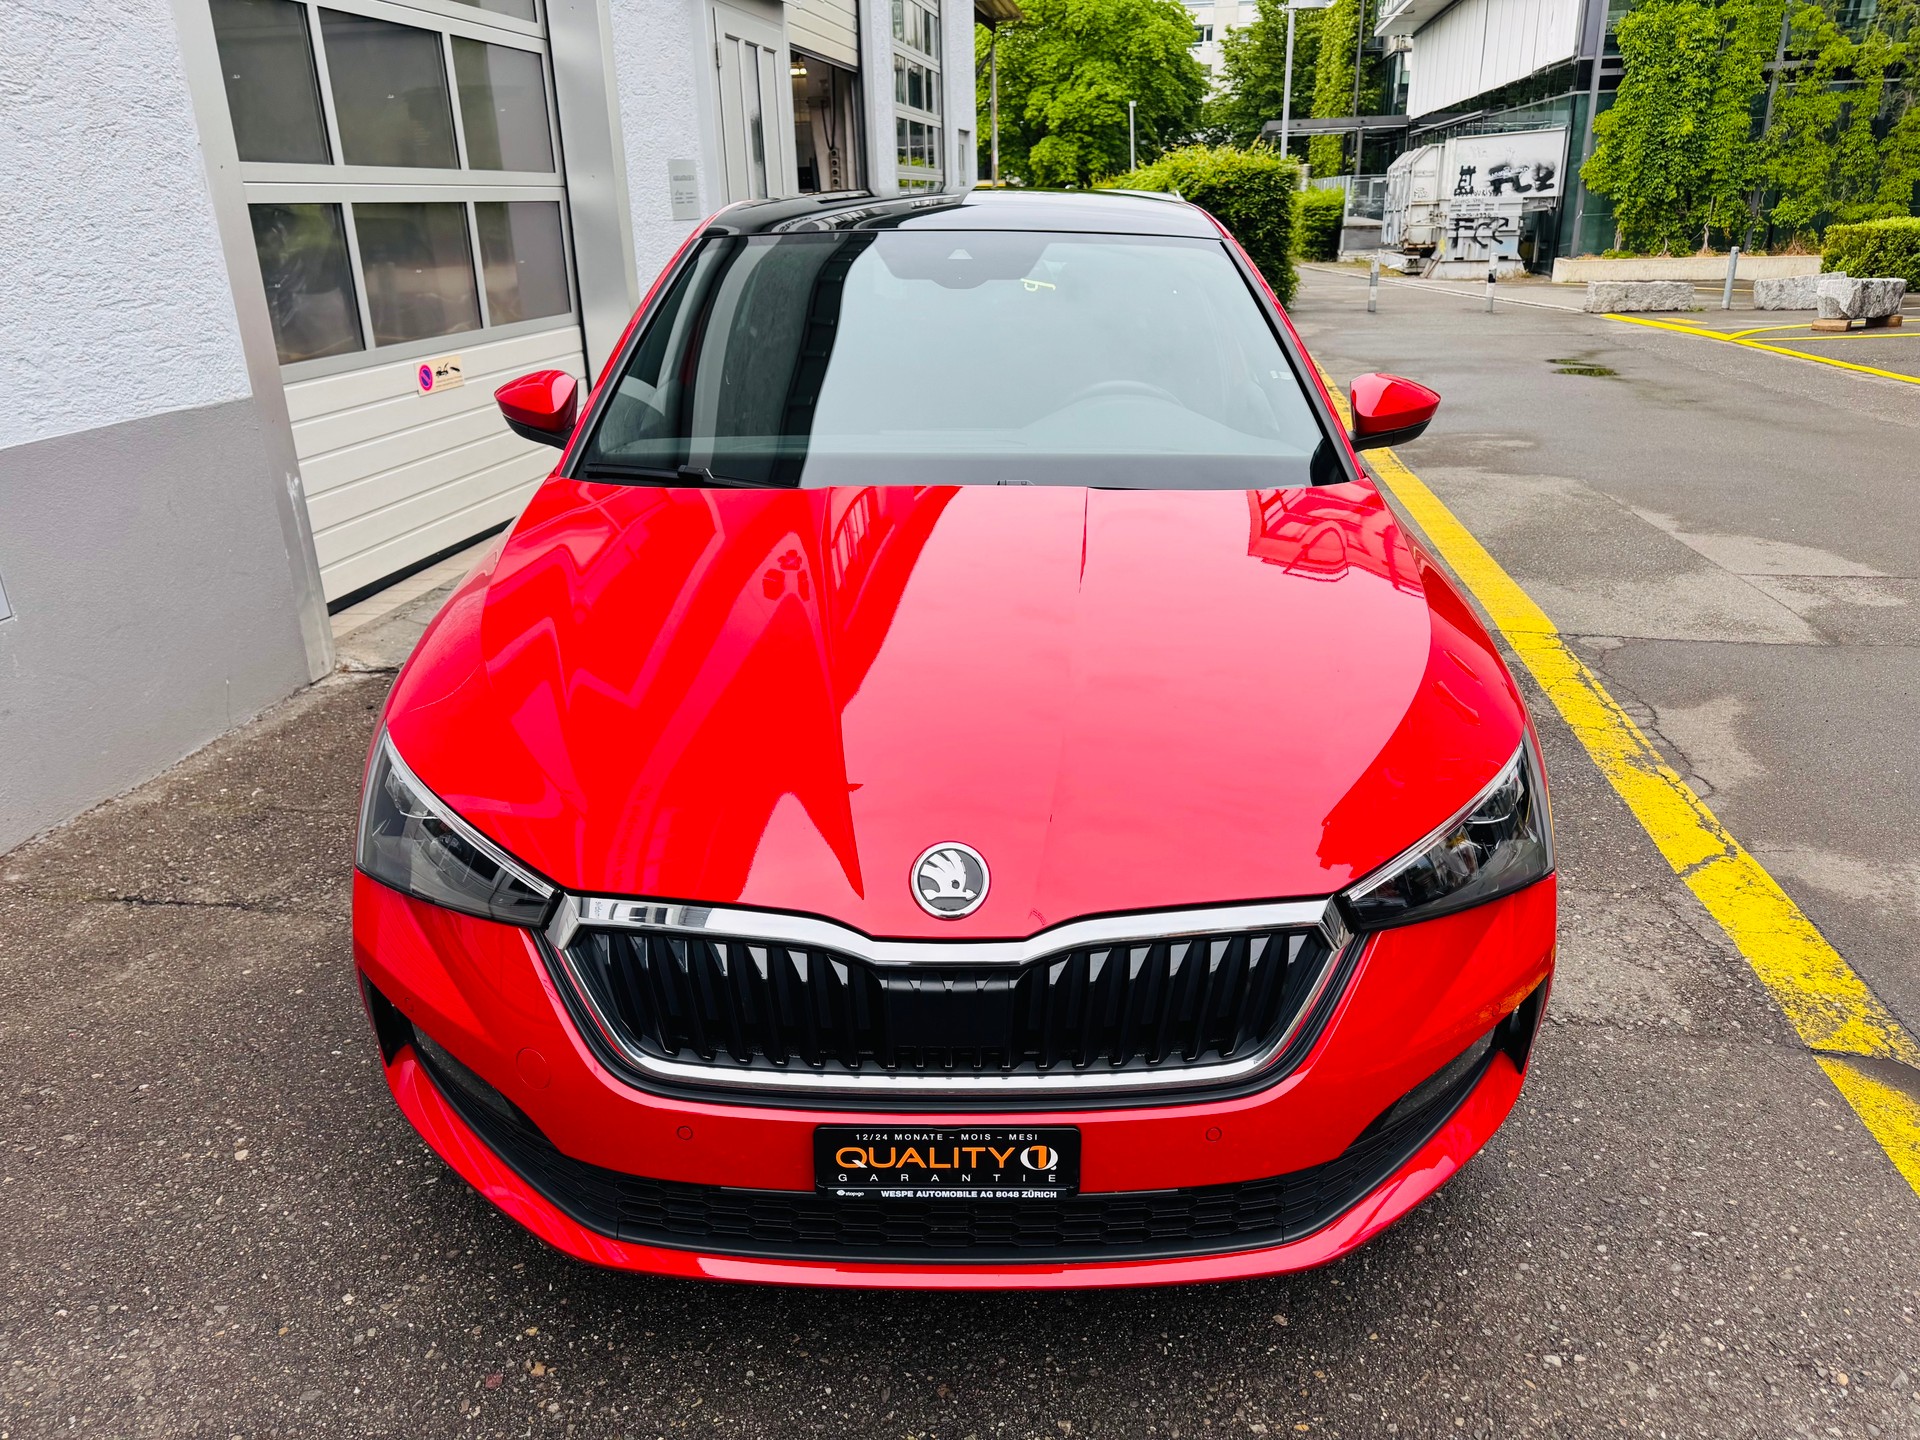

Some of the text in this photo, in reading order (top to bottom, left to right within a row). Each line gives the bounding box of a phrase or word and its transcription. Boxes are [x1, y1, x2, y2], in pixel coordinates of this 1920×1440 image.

[855, 1133, 888, 1141] 12/24
[894, 1133, 943, 1141] MONATE
[960, 1133, 991, 1141] MOIS
[1008, 1133, 1038, 1141] MESI
[835, 1146, 1016, 1169] QUALITY
[838, 1173, 1056, 1182] GARANTIE
[881, 1190, 914, 1198] WESPE
[916, 1190, 978, 1198] AUTOMOBILE
[980, 1190, 994, 1198] AG
[996, 1190, 1020, 1198] 8048
[1021, 1189, 1057, 1199] ZÜRICH
